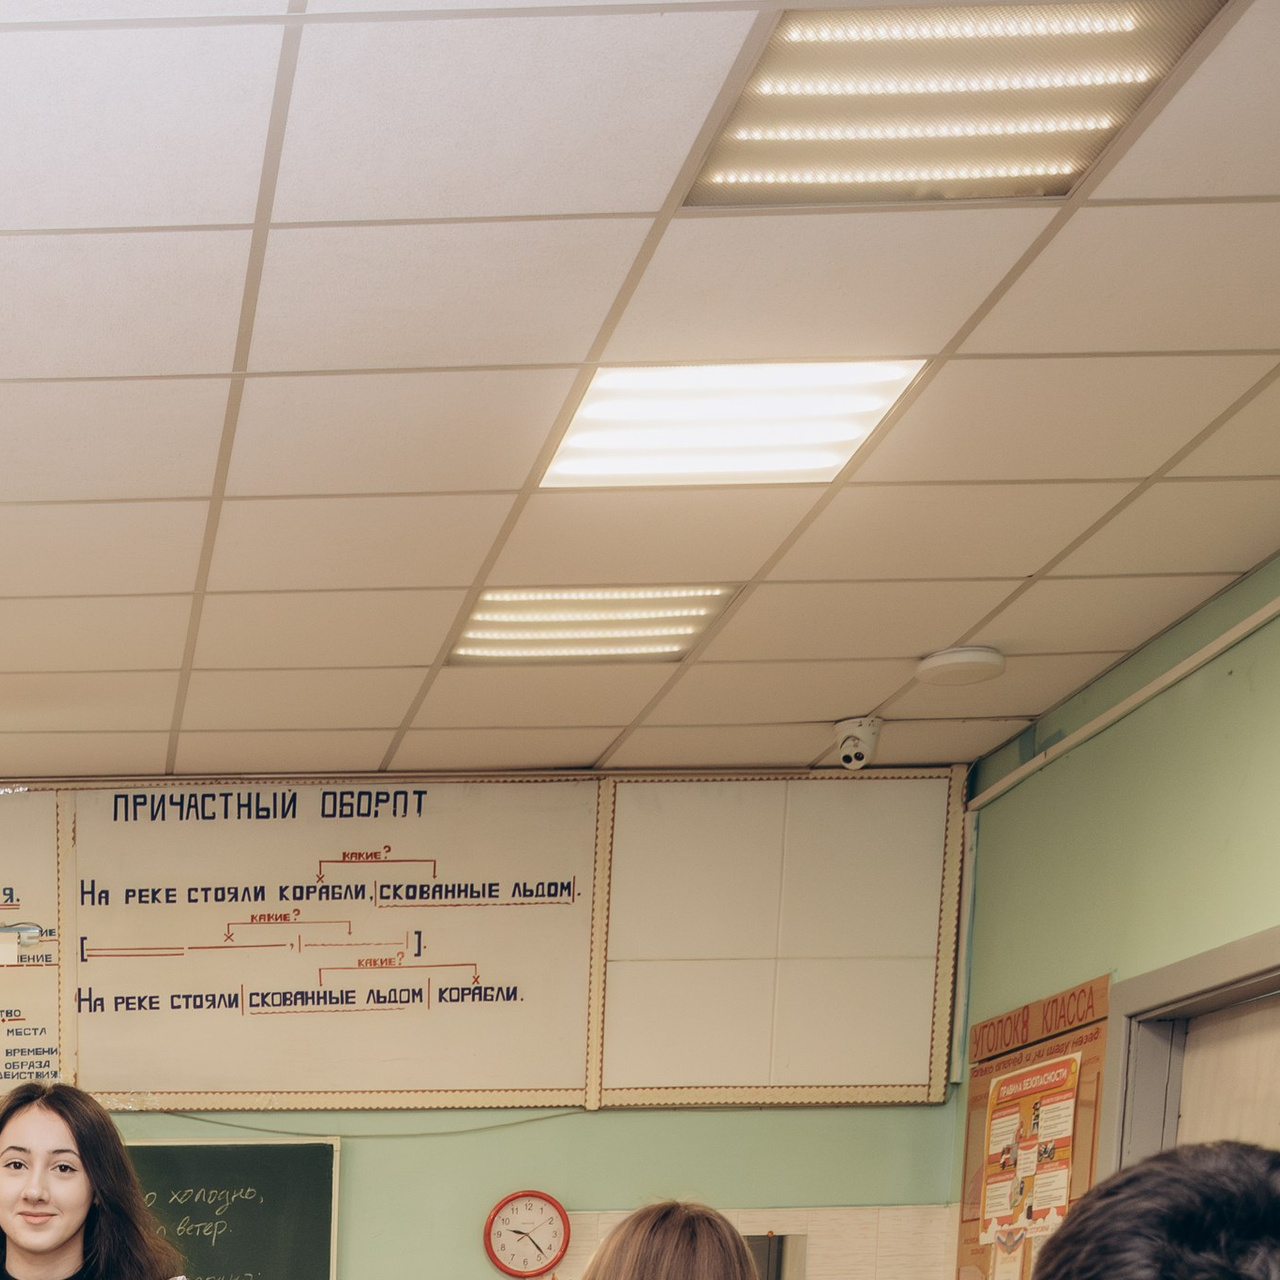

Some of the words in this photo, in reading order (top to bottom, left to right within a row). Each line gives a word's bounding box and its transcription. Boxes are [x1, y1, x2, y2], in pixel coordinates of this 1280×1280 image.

[113, 789, 297, 822] ПРИЧАСТНЫЙ
[125, 887, 177, 905] РЕКЕ
[187, 885, 266, 904] СТОЯЛИ
[379, 881, 500, 902] СКОВАННЫЕ
[114, 995, 160, 1012] РЕКЕ
[170, 993, 240, 1011] СТОЯЛИ
[249, 989, 357, 1009] СКОВАННЫЕ
[366, 987, 423, 1006] ЛЬДОМ
[973, 1012, 1021, 1058] УГОЛОК
[1041, 985, 1095, 1034] КЛАССА
[6, 1027, 47, 1036] МЕСТА
[5, 1047, 58, 1057] ВРЕМЕНИ
[4, 1060, 51, 1070] ОБРАЗА
[525, 1203, 533, 1211] 12
